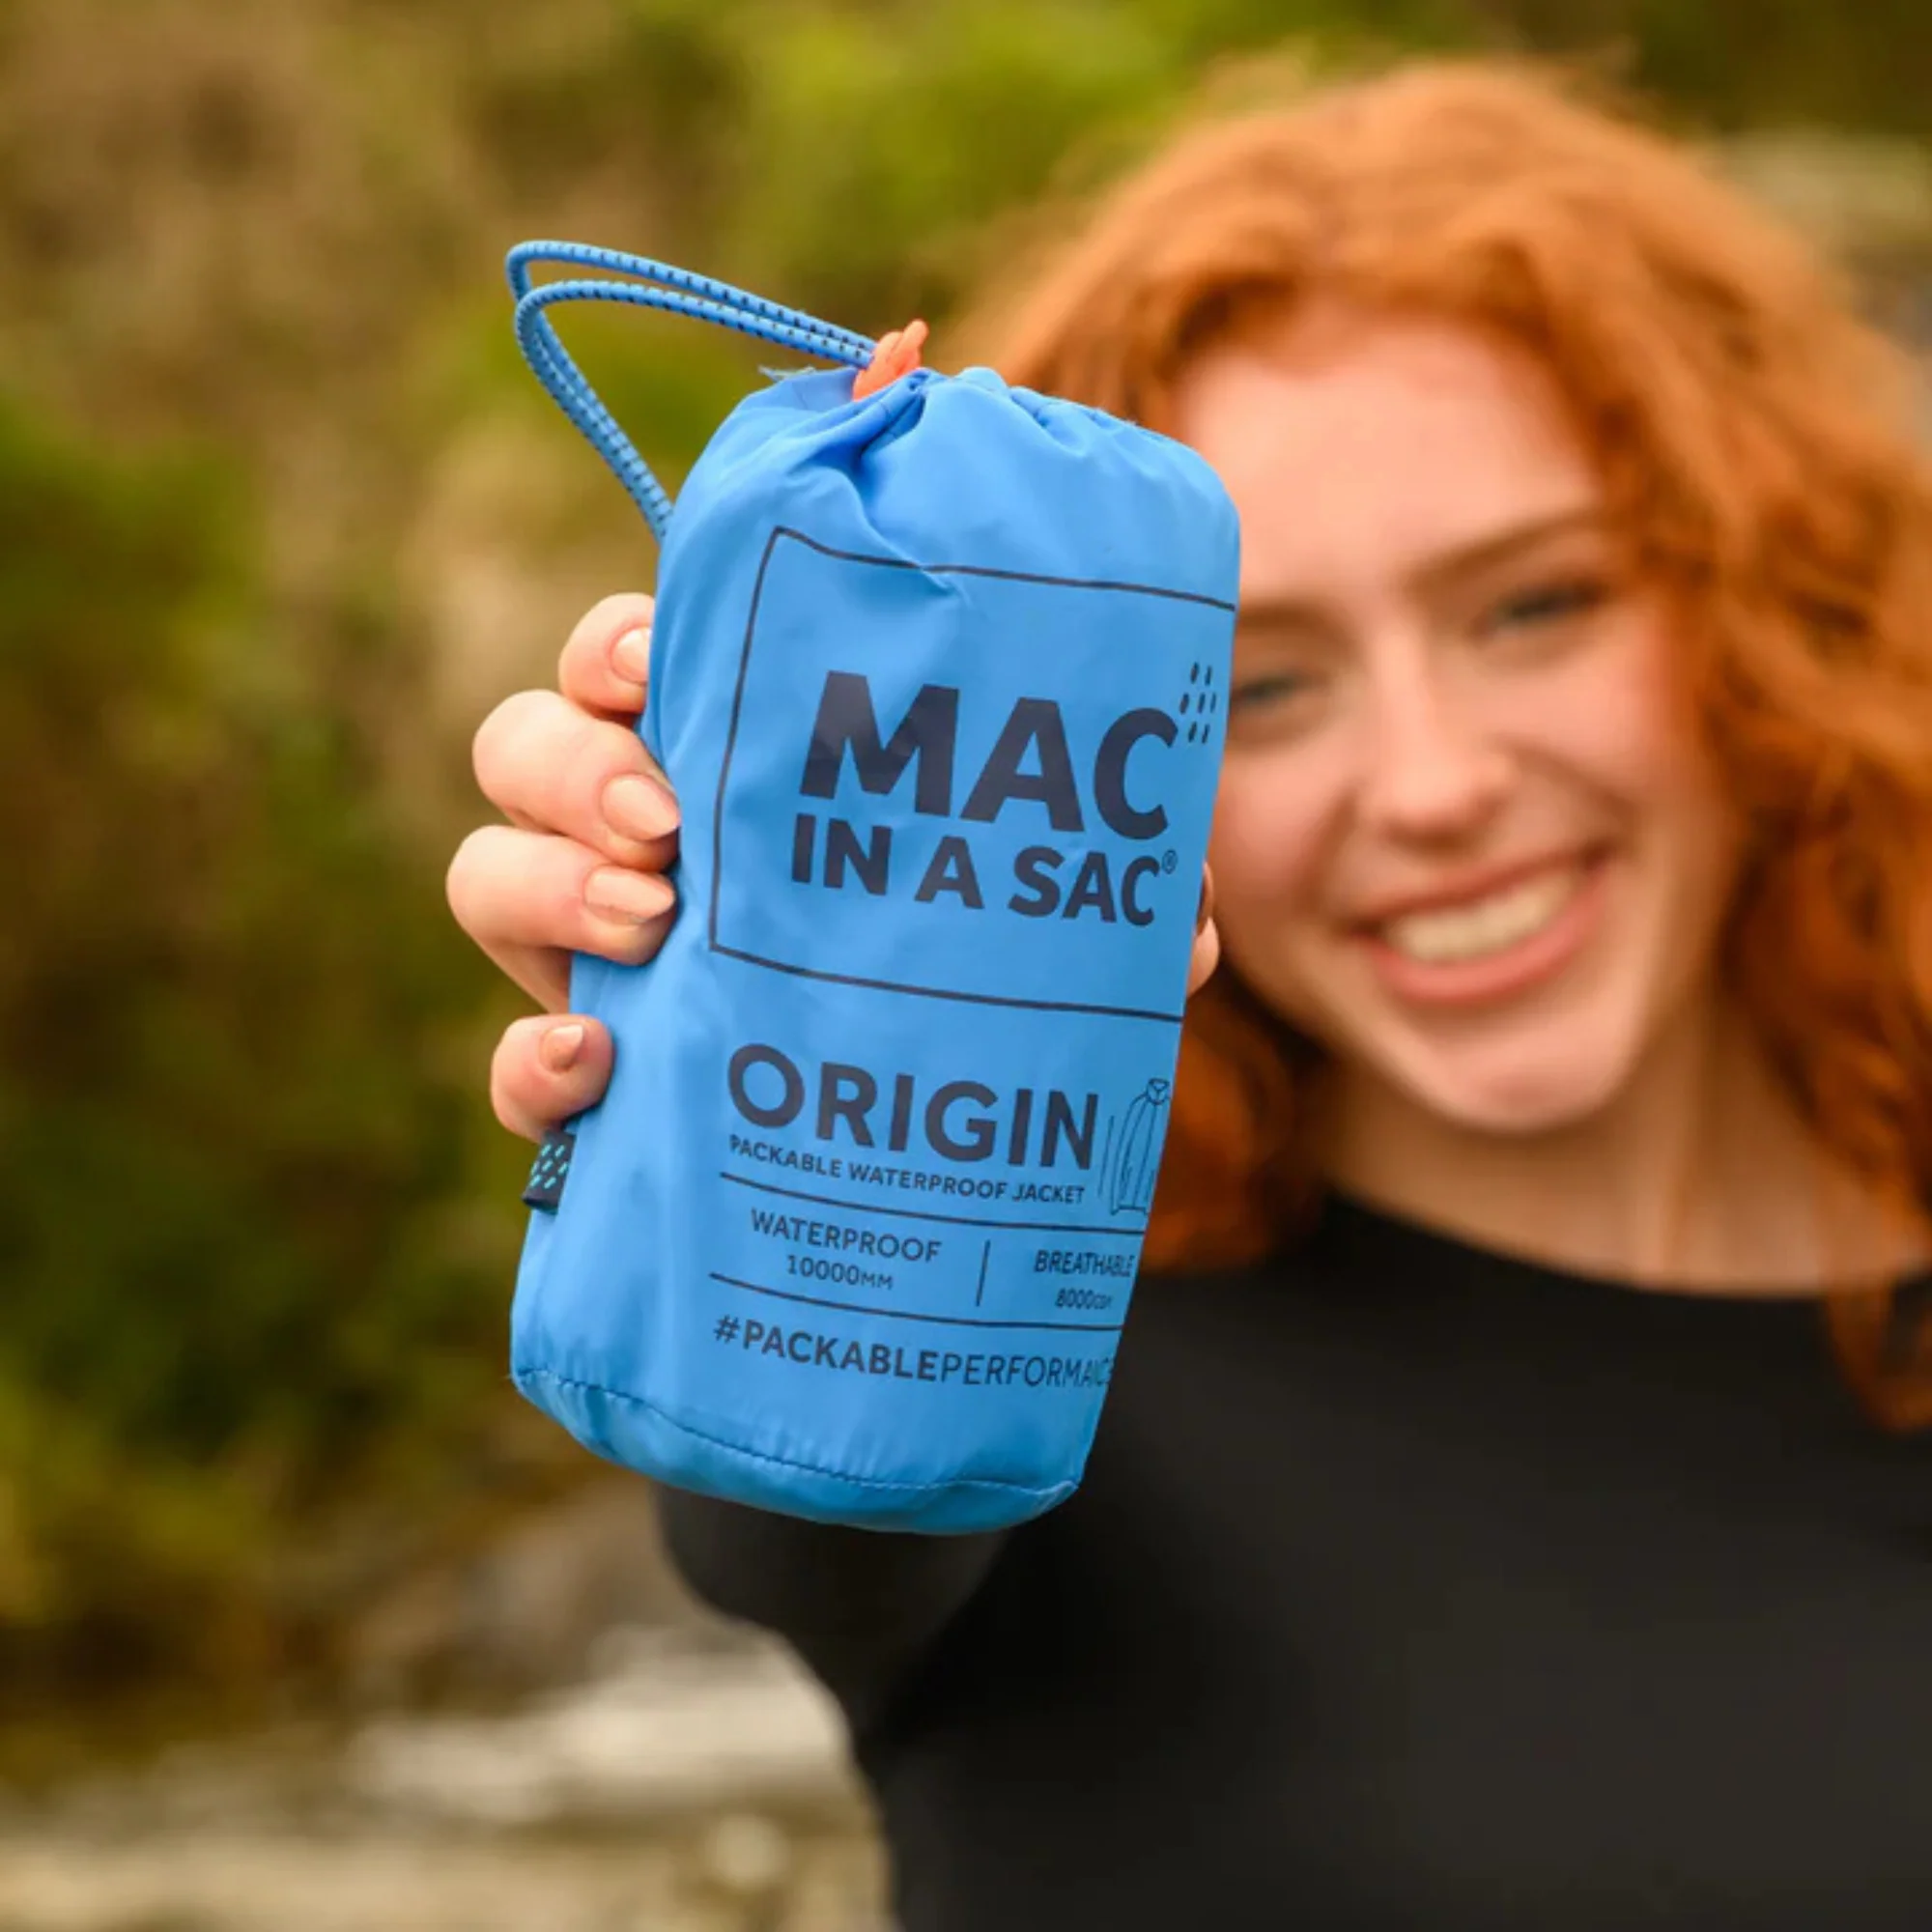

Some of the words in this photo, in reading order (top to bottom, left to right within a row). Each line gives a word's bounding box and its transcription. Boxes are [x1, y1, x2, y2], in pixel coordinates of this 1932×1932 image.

[800, 670, 1179, 839] MAC
[791, 813, 892, 895] IN
[914, 836, 984, 909] A
[727, 1043, 1098, 1170] ORIGIN
[729, 1134, 841, 1178] PACKABLE
[848, 1164, 1008, 1200] WATERPROOF
[1011, 1184, 1085, 1205] JACKET
[751, 1208, 942, 1263] WATERPROOF
[1034, 1249, 1136, 1278] BREATHABLE
